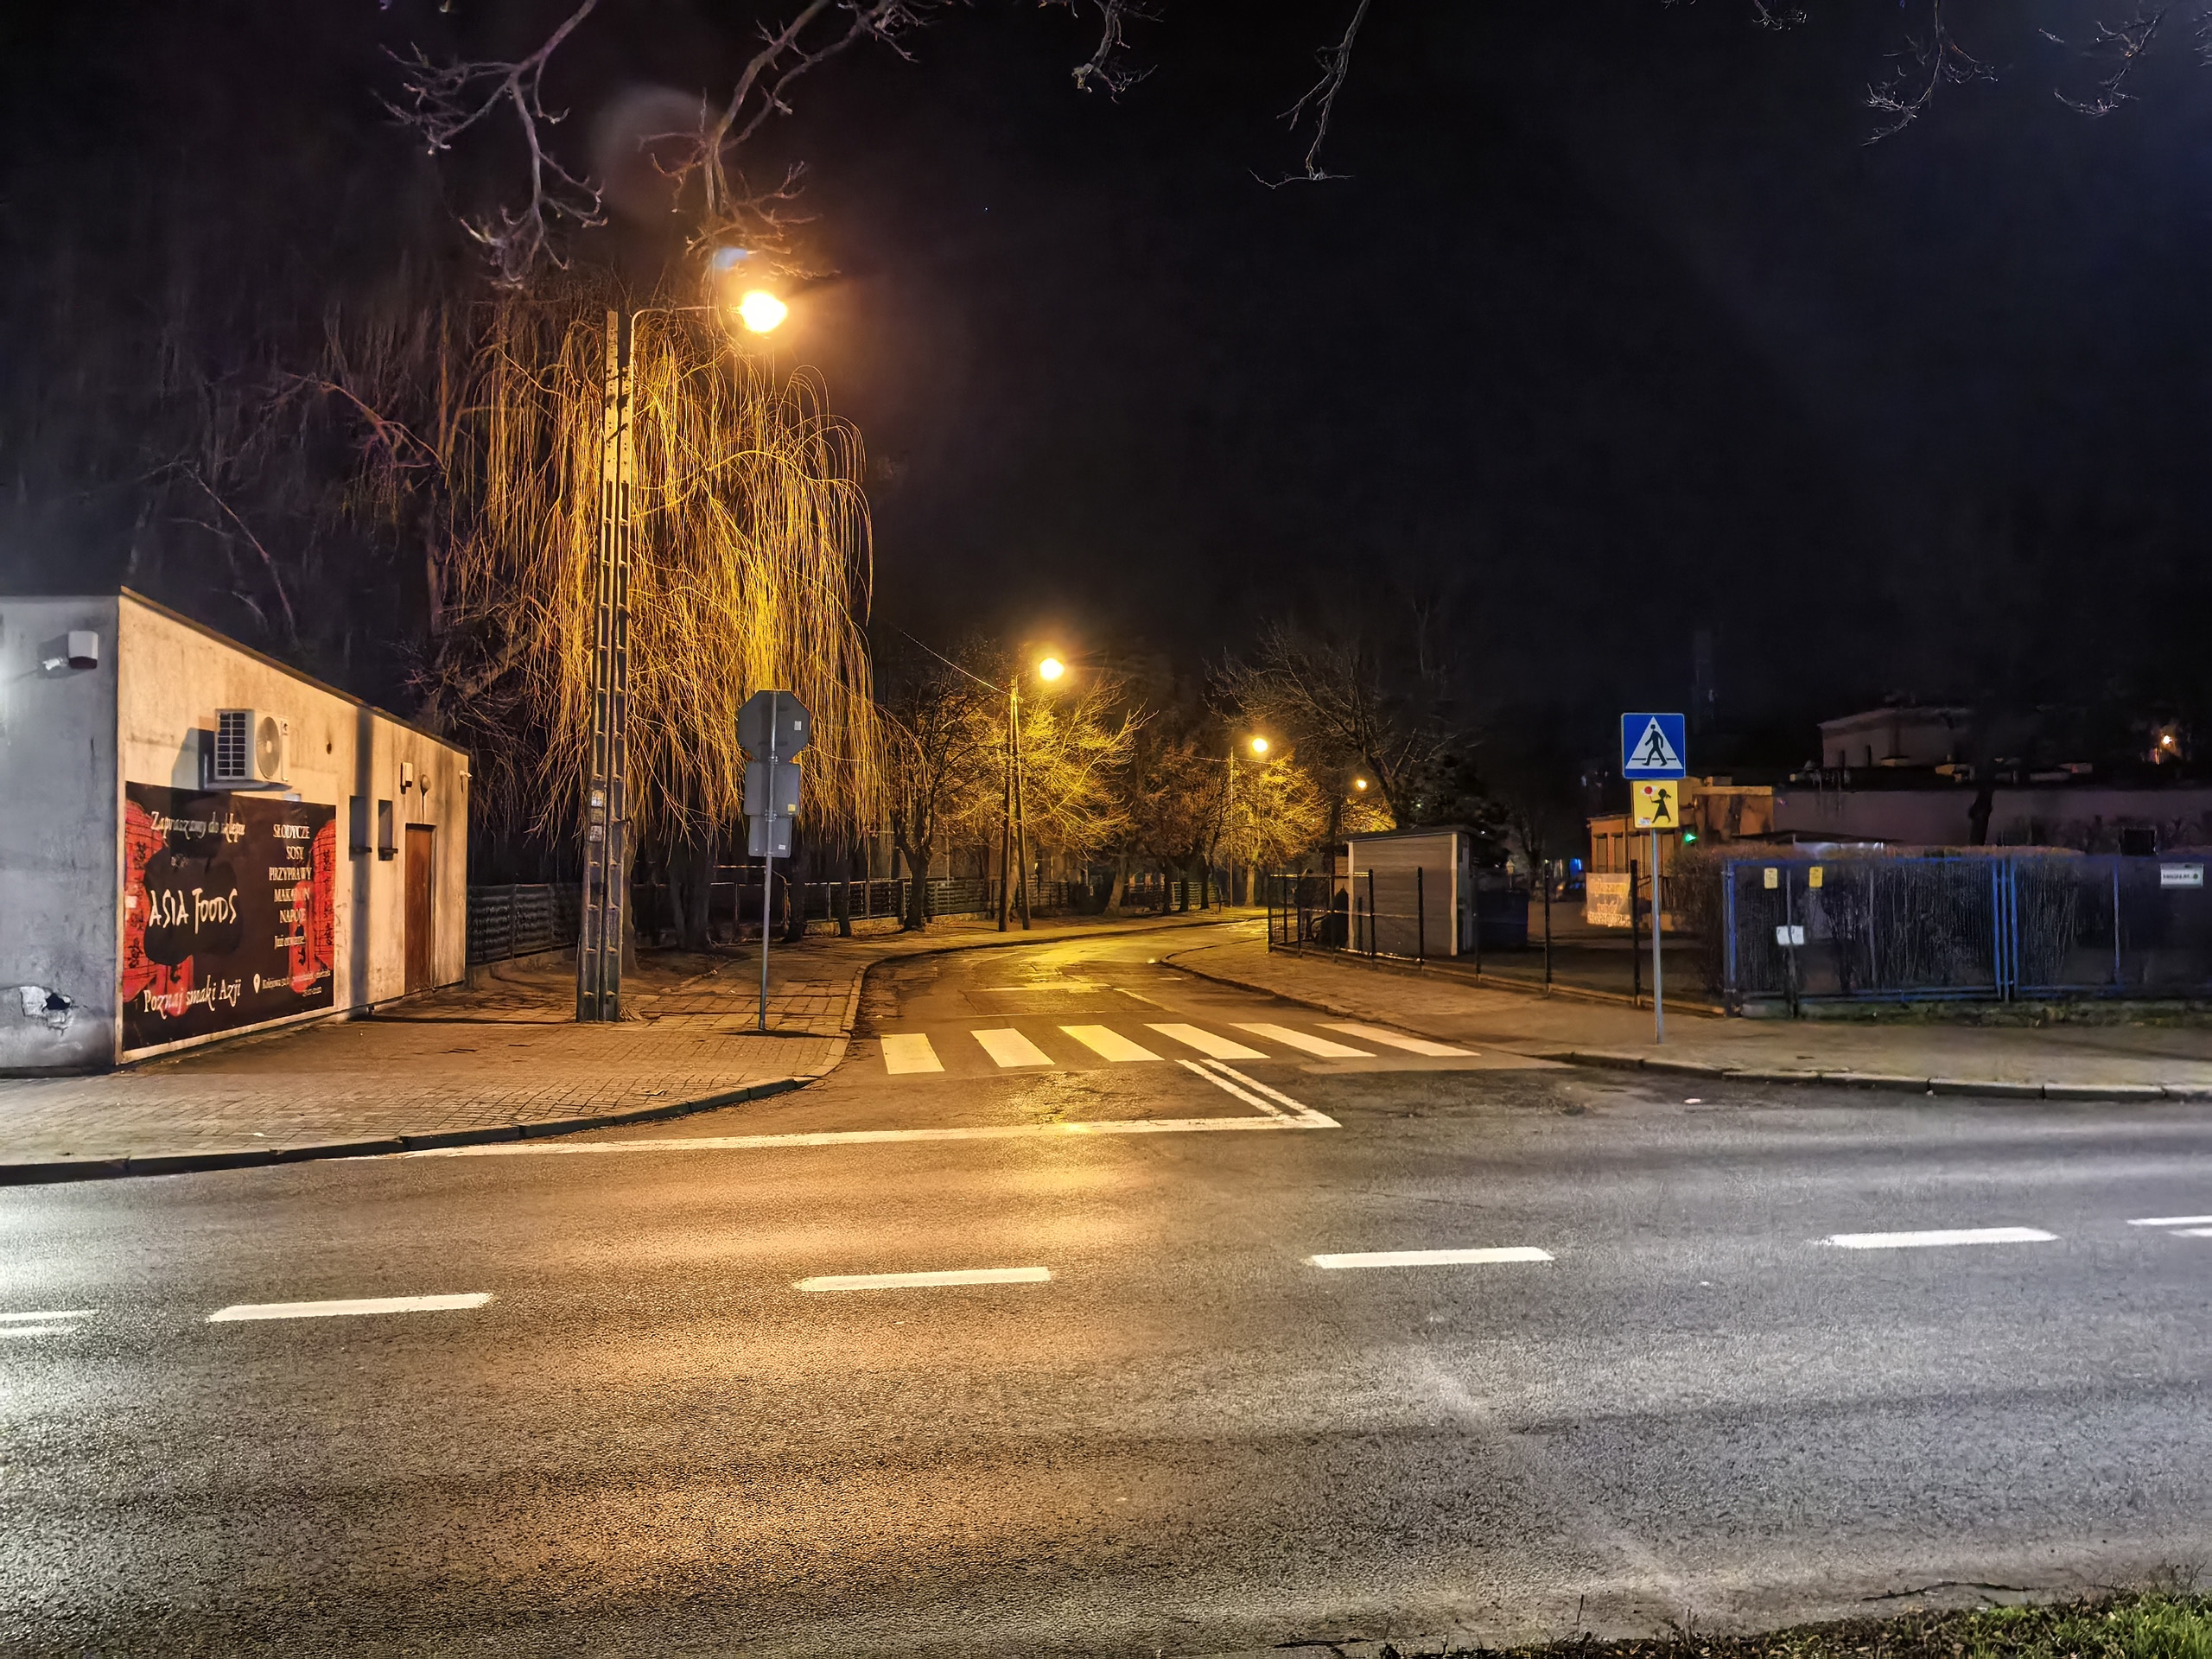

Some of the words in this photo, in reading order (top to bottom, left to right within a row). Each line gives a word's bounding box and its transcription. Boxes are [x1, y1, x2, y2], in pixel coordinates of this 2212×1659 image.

[150, 810, 207, 840] Zapraszamy
[208, 811, 219, 833] do
[221, 812, 245, 842] sklepu
[272, 823, 310, 839] SŁODYCZE
[286, 845, 304, 860] SOSY
[269, 867, 312, 880] PRZYPRAWY
[149, 888, 189, 929] ASIA
[143, 988, 184, 1020] Poznaj
[186, 975, 216, 1012] smaki
[219, 978, 242, 1007] Azji
